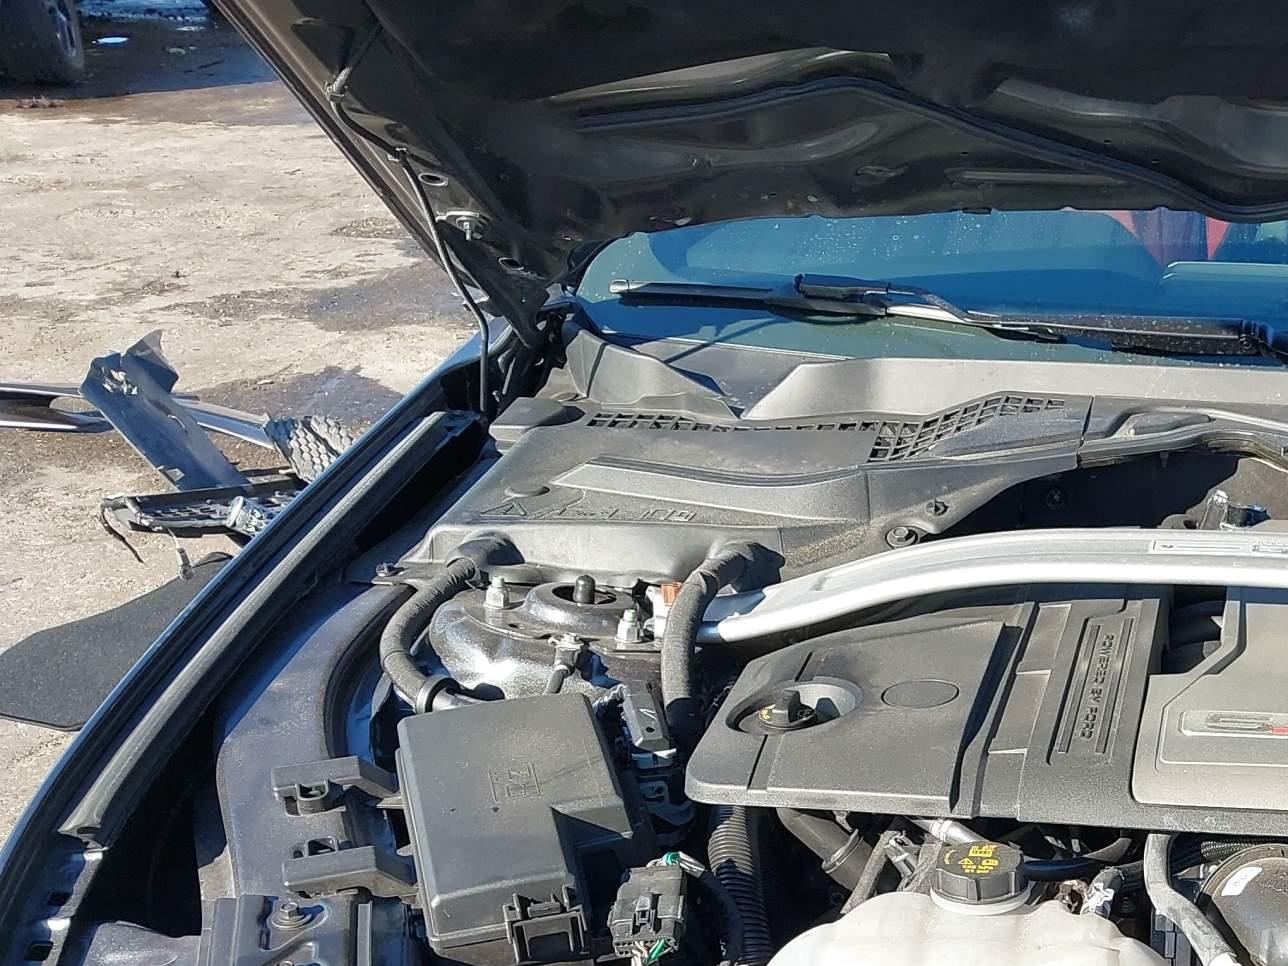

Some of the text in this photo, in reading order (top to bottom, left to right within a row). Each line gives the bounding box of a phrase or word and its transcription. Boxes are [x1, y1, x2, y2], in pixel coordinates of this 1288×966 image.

[1080, 633, 1114, 739] POWERED BY FORD
